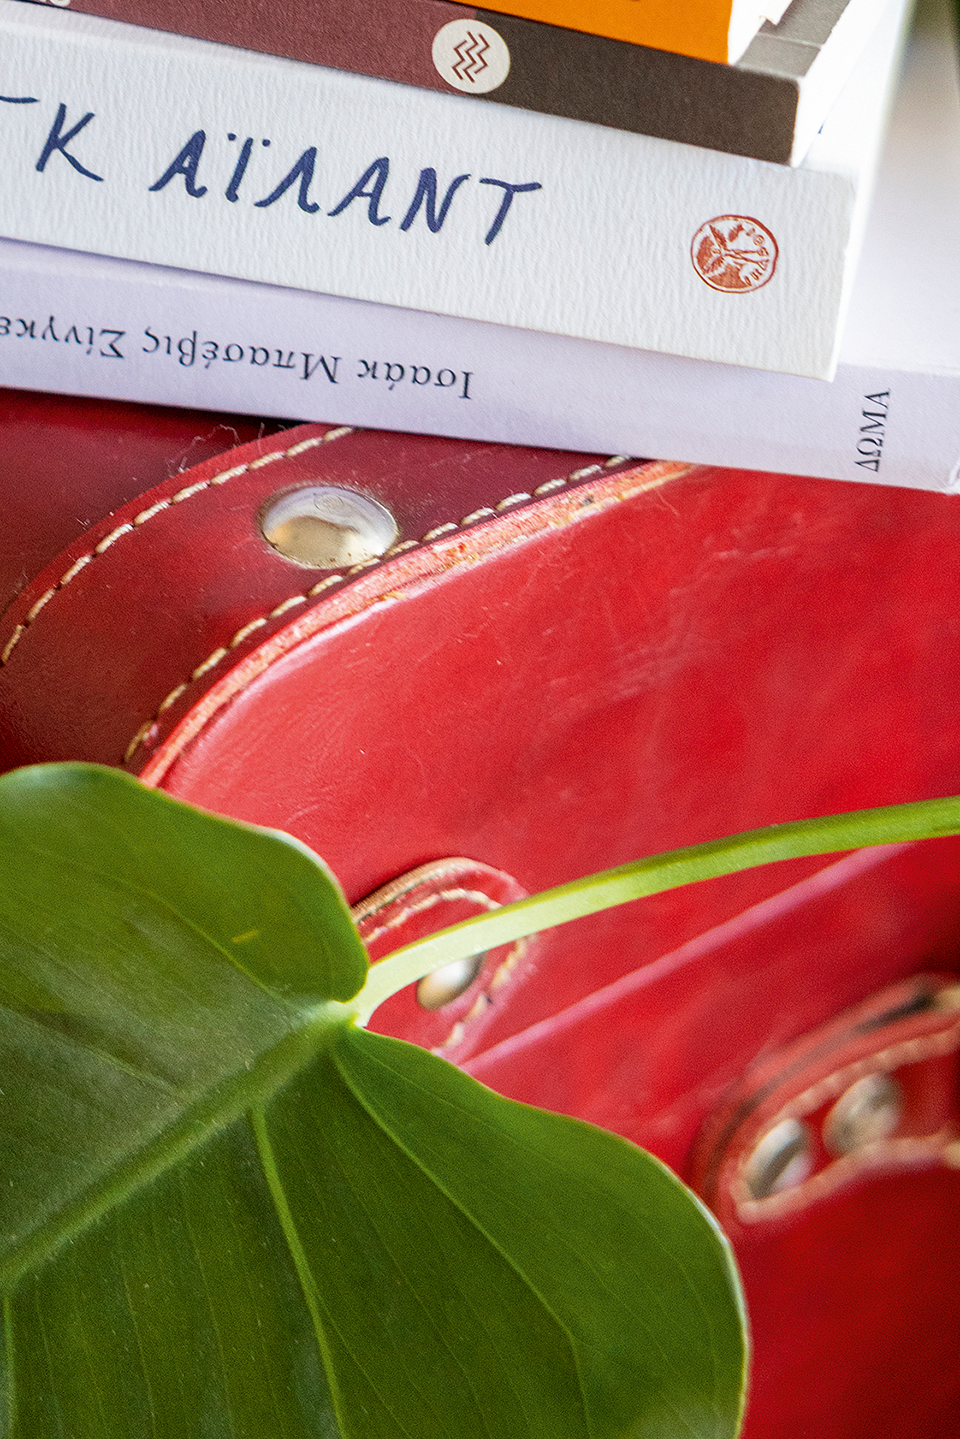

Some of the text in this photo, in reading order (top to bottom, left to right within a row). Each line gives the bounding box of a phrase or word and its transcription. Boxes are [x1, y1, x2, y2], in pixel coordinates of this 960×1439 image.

[149, 129, 542, 246] ΑΪΛΑΝΤ
[144, 328, 339, 385] Μπασέβις
[356, 358, 474, 402] Ισαάκ
[854, 388, 890, 472] ΔΩΜΑ
